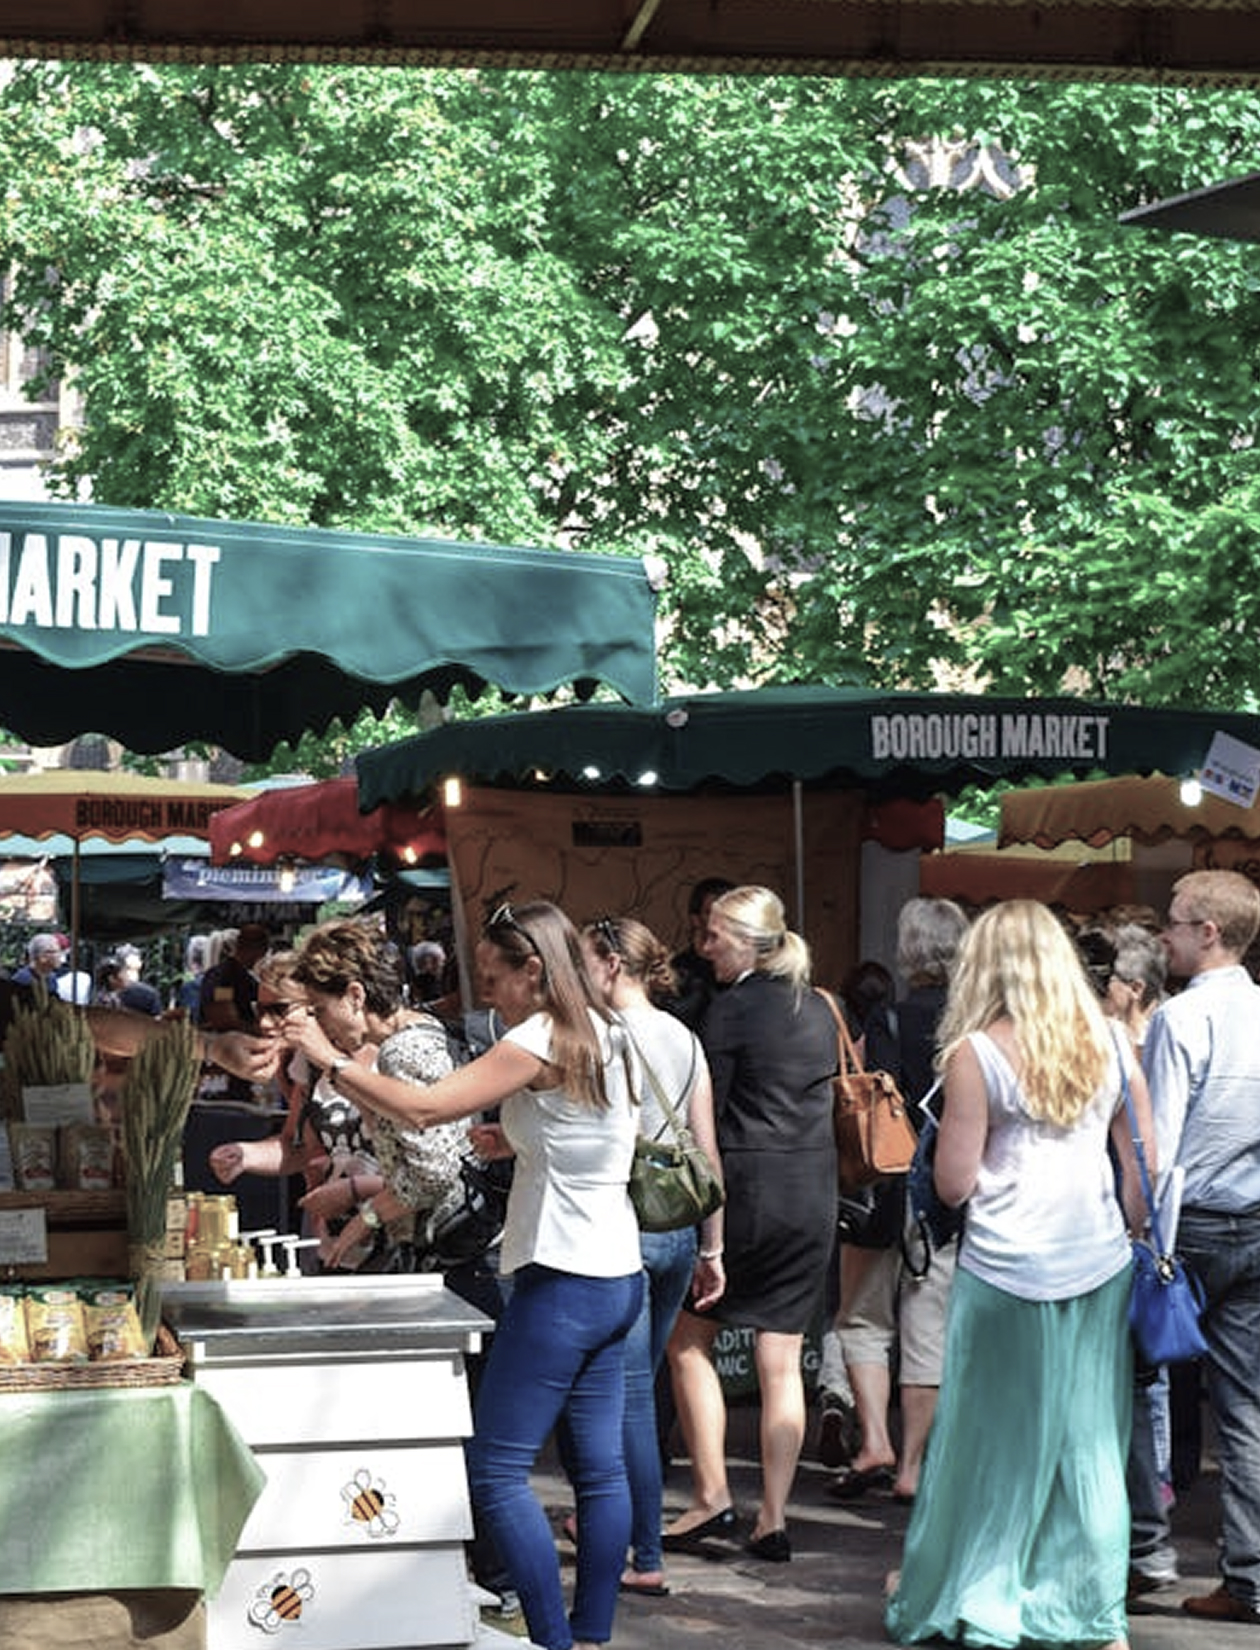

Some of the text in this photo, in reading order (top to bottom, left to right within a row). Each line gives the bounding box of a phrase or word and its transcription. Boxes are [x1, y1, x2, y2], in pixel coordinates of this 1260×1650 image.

[0, 532, 221, 636] ARKET
[871, 714, 1110, 759] BOROUGH MARKET
[76, 799, 233, 829] BOROUGH MAR
